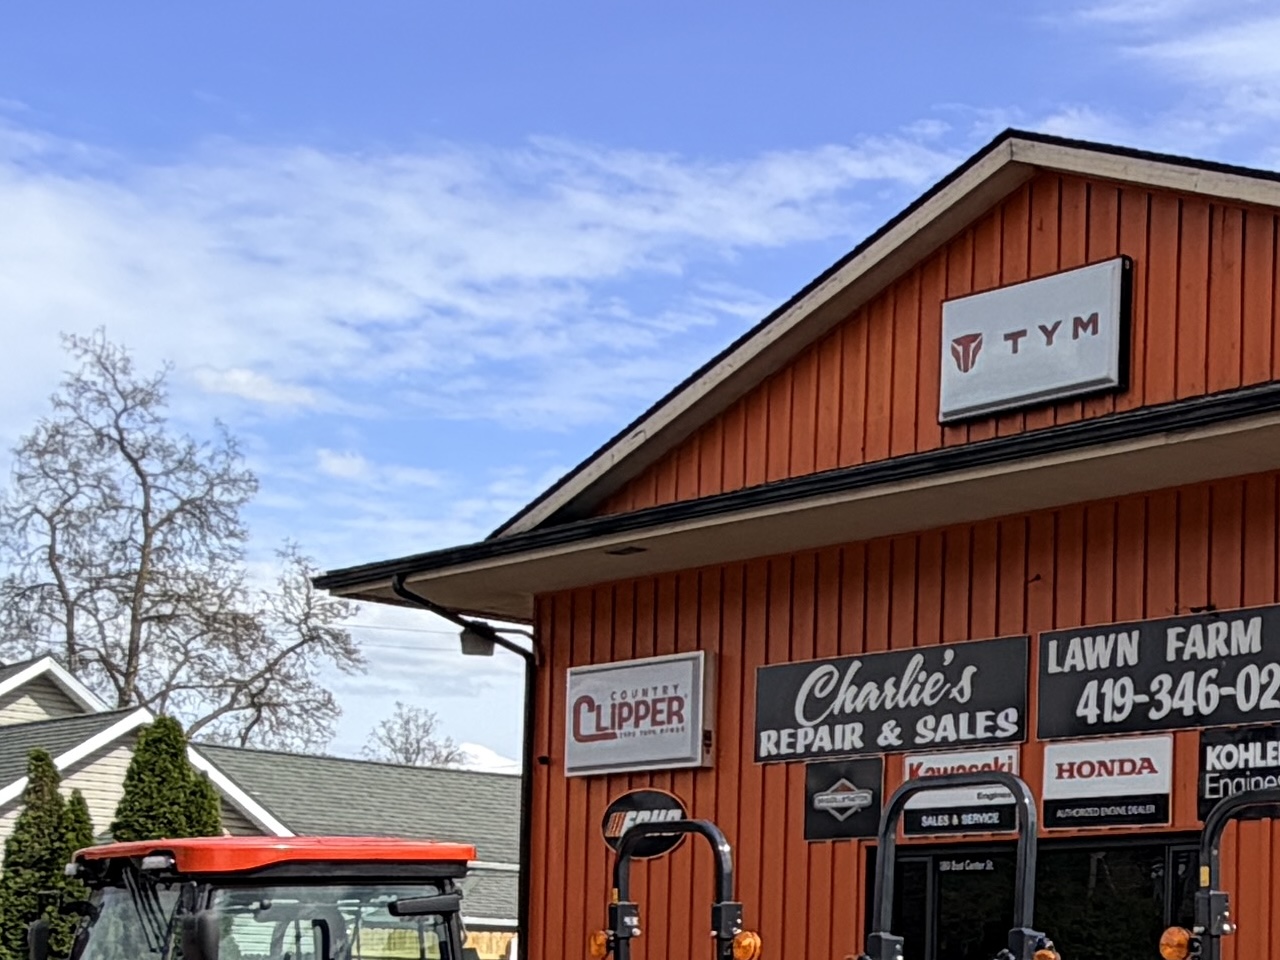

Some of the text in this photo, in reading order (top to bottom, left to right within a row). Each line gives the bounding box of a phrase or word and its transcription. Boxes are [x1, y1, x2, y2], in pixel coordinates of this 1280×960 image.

[1003, 312, 1099, 354] TYM
[1048, 630, 1140, 674] LAWN
[1166, 617, 1262, 661] FARM
[610, 684, 680, 701] COUNTRY
[794, 649, 978, 727] Charlie's
[759, 707, 1019, 758] REPAIR & SALES
[1055, 757, 1159, 779] HONDA
[921, 814, 950, 827] SALES
[961, 812, 1000, 825] SERVICE
